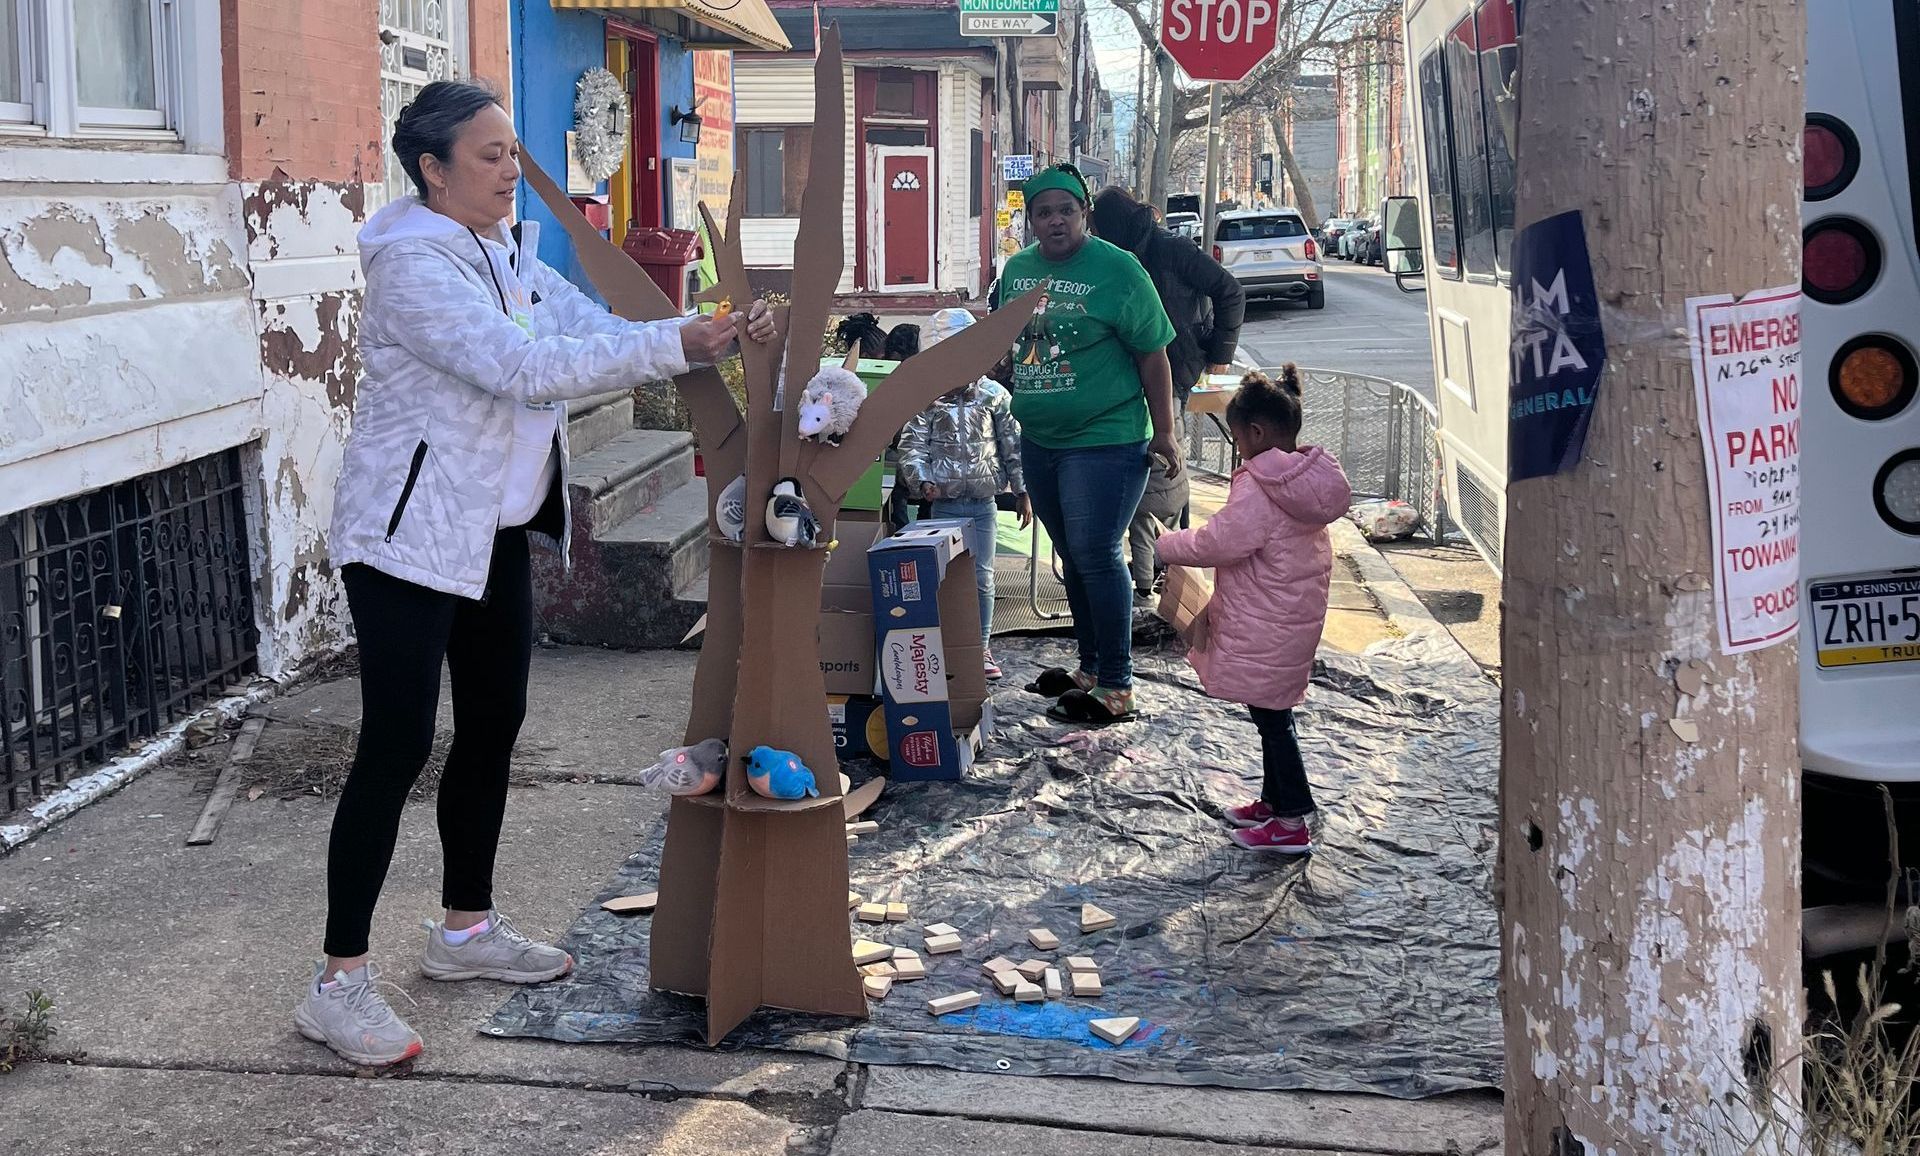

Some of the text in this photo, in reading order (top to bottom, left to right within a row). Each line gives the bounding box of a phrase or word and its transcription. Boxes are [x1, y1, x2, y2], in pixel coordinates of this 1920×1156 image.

[963, 0, 1055, 10] MONTGOMERY AV
[973, 19, 1029, 29] ONE WAY
[1168, 0, 1272, 43] STOP
[1010, 160, 1026, 169] 215
[1039, 278, 1096, 296] MEBODY
[1772, 374, 1799, 414] NO
[1728, 499, 1763, 517] FROM
[819, 660, 860, 673] sports
[890, 642, 905, 690] Cantaloupes
[910, 633, 930, 696] Majesty
